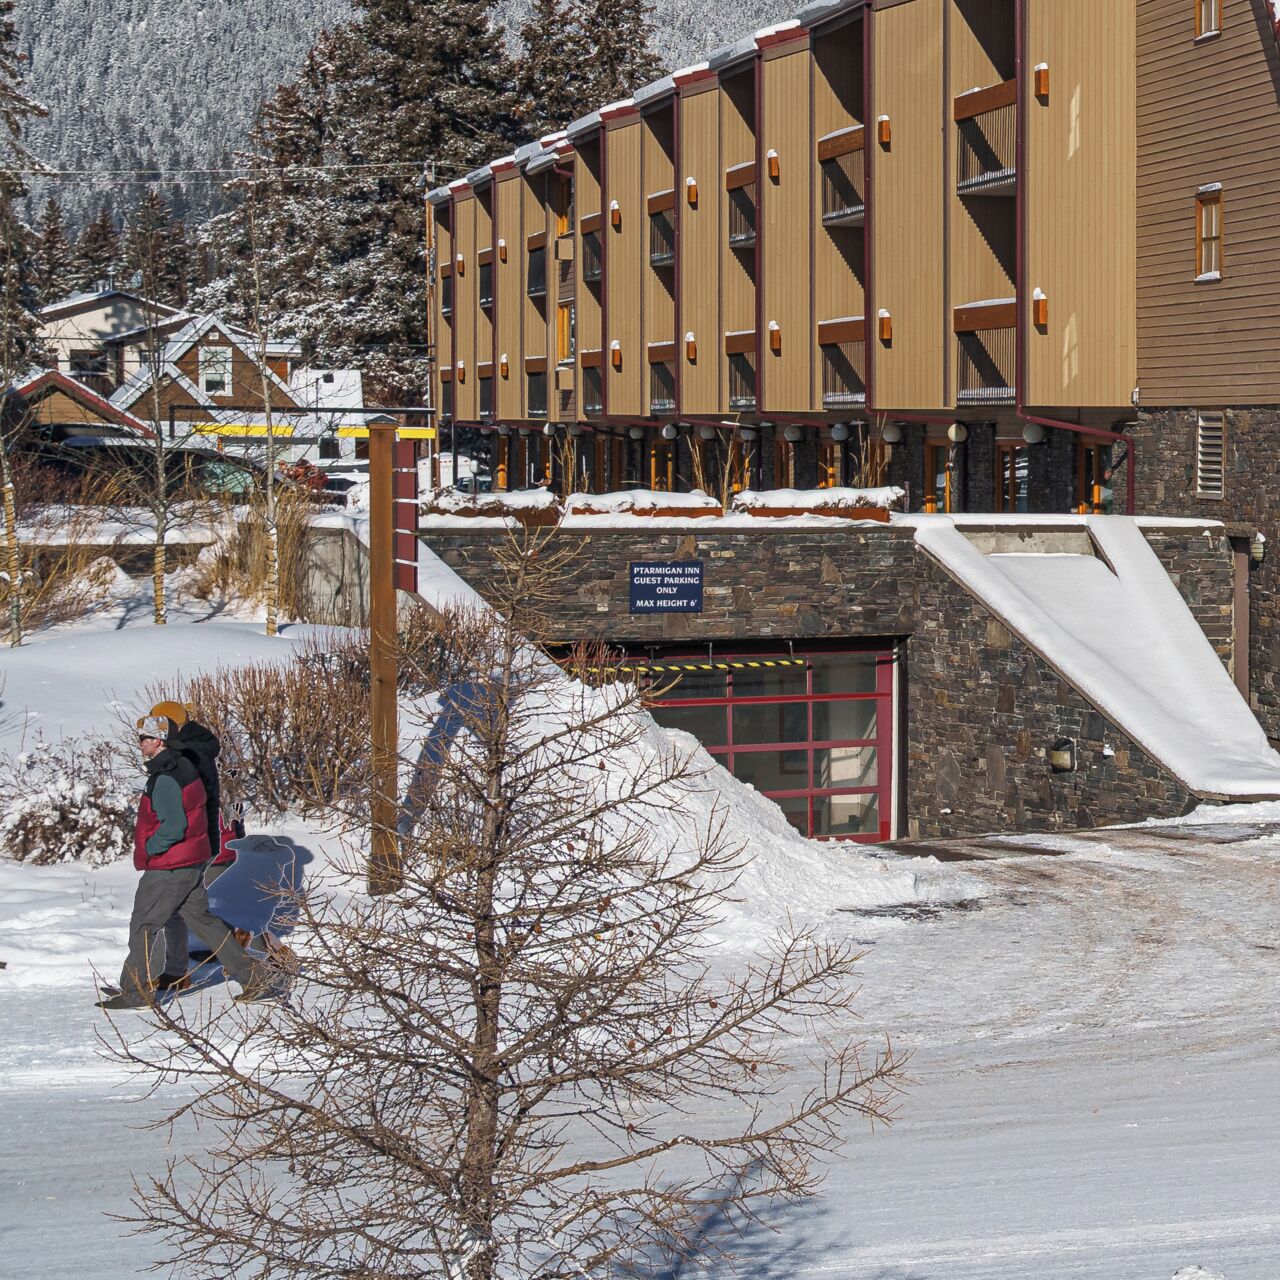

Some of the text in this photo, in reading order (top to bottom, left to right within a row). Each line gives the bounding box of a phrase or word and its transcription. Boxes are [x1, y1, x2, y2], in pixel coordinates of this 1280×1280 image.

[633, 567, 700, 575] PTARMIGAN INN
[633, 577, 700, 585] GUEST PARKING
[656, 586, 678, 594] ONLY
[690, 599, 698, 607] 6'
